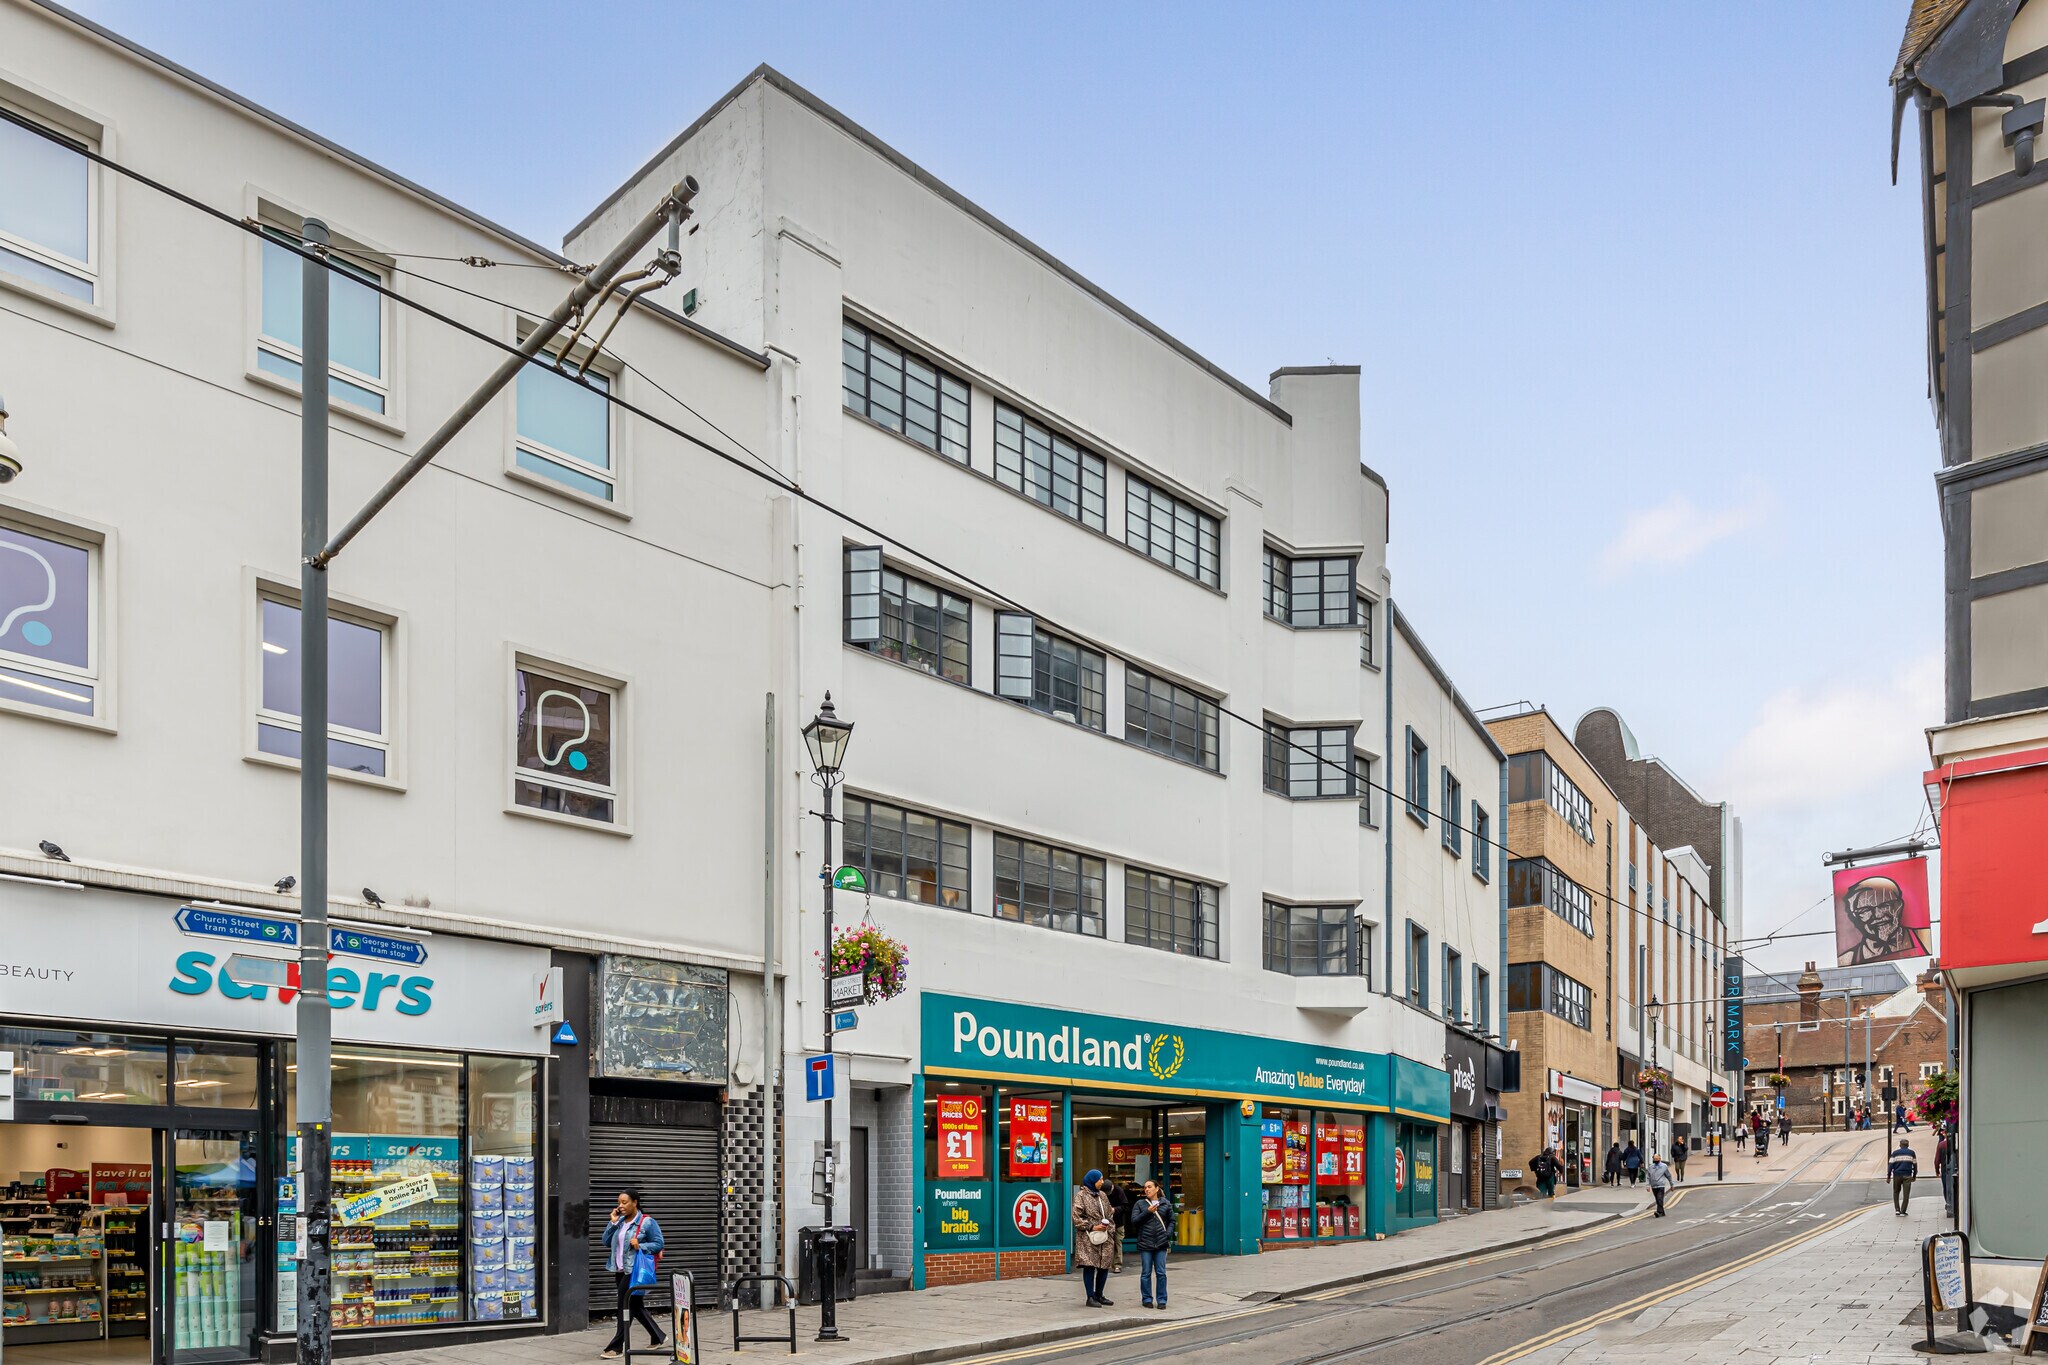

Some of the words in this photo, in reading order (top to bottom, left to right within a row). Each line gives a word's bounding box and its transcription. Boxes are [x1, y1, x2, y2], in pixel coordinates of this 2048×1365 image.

[193, 912, 228, 925] Church
[231, 917, 260, 930] Street
[204, 923, 226, 934] tram
[229, 925, 250, 937] stop
[362, 937, 389, 949] George
[391, 941, 414, 953] Street
[370, 945, 388, 955] tram
[390, 948, 406, 959] stop
[0, 964, 74, 981] BEAUTY
[833, 984, 862, 999] MARKET
[535, 1000, 553, 1015] savers
[1315, 1057, 1365, 1071] www.poundland.co.uk
[1255, 1066, 1295, 1090] Amazing
[1297, 1071, 1324, 1089] Value
[1326, 1074, 1366, 1096] Everyday!
[942, 1111, 963, 1119] PRICES
[1014, 1104, 1027, 1117] £1
[387, 1143, 443, 1157] savers
[946, 1131, 973, 1158] £1
[1346, 1152, 1361, 1172] £1
[96, 1168, 125, 1178] save
[128, 1168, 137, 1178] it
[1414, 1161, 1433, 1180] Value
[383, 1187, 396, 1196] Buy
[389, 1191, 410, 1202] Online
[411, 1184, 429, 1195] 24/7
[935, 1188, 982, 1200] Poundland
[342, 1193, 378, 1212] INFLATION
[350, 1199, 378, 1216] BUSTING
[951, 1207, 969, 1222] big
[1018, 1201, 1043, 1229] £1
[1319, 1215, 1330, 1227] £1
[941, 1220, 979, 1234] brands
[969, 1233, 980, 1241] less!
